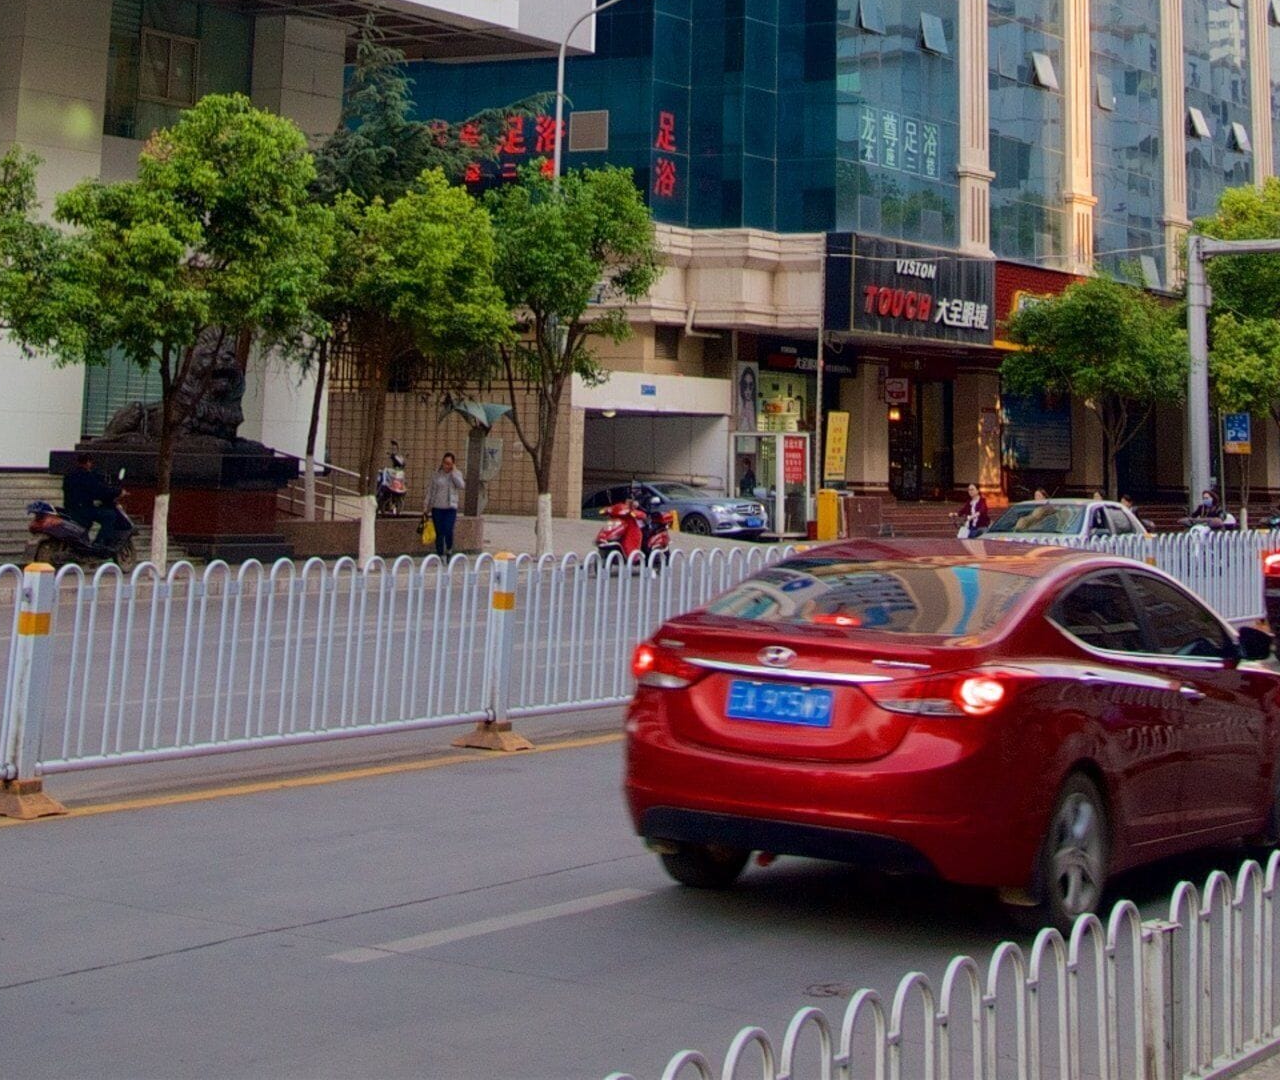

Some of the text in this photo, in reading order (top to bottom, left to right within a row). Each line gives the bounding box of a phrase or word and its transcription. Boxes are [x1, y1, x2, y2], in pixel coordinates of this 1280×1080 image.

[654, 110, 677, 197] 足浴
[895, 258, 937, 280] VISION
[863, 284, 933, 322] TOUCH
